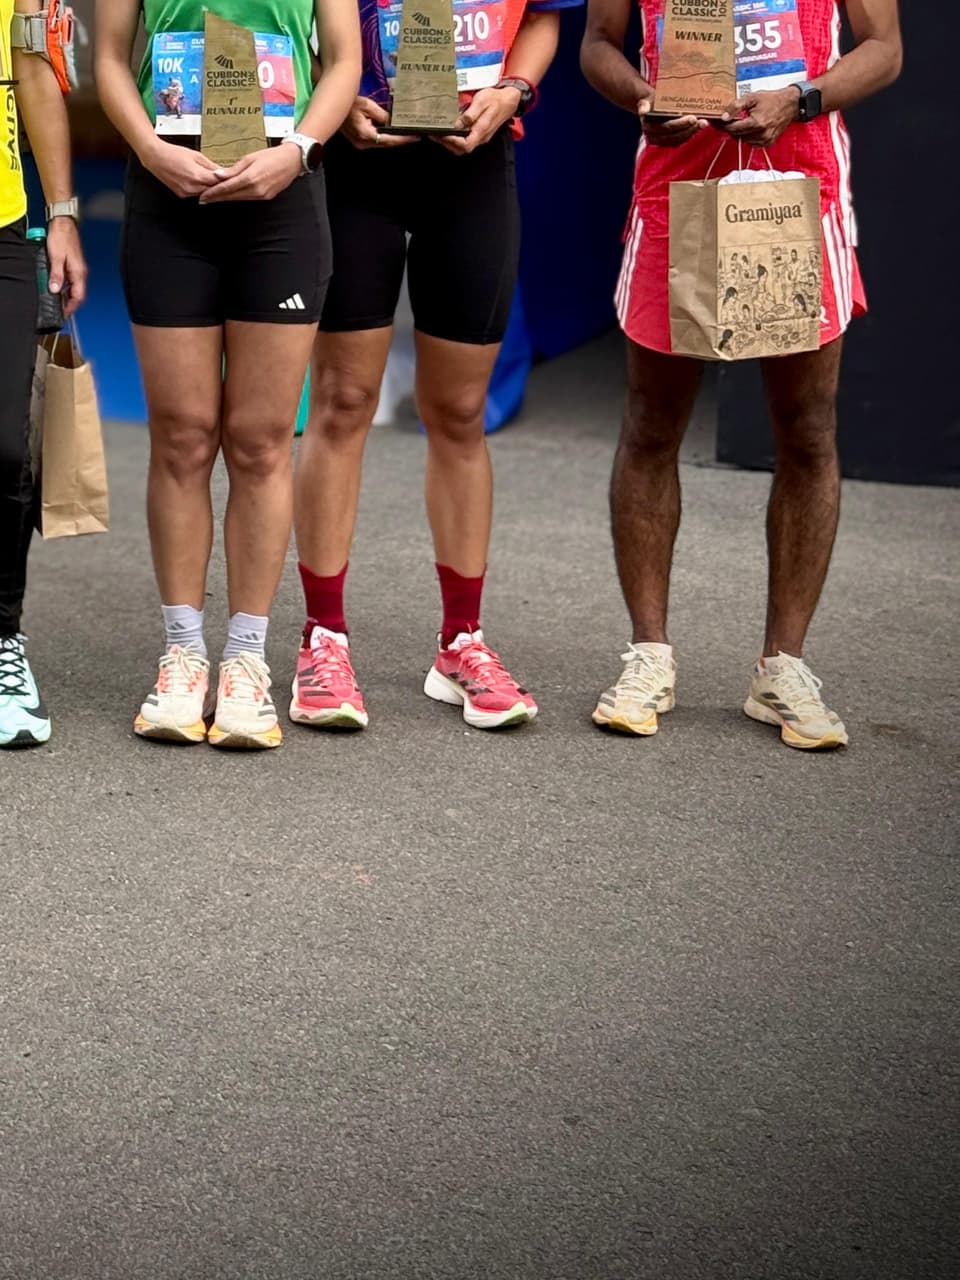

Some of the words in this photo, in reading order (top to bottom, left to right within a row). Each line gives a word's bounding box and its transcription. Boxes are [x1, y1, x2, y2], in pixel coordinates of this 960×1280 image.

[671, 6, 717, 18] CLASSIC
[718, 0, 728, 17] 10K
[384, 20, 400, 37] 10
[403, 27, 444, 36] CUBBON
[452, 10, 490, 43] 210
[403, 35, 443, 45] CLASSIC
[675, 30, 722, 42] WINNER
[157, 56, 185, 74] 10K
[207, 70, 248, 79] CUBBON
[207, 79, 247, 88] CLASSIC
[206, 106, 246, 116] RUNNER
[247, 106, 262, 115] UP
[725, 202, 803, 225] Gramiyaa
